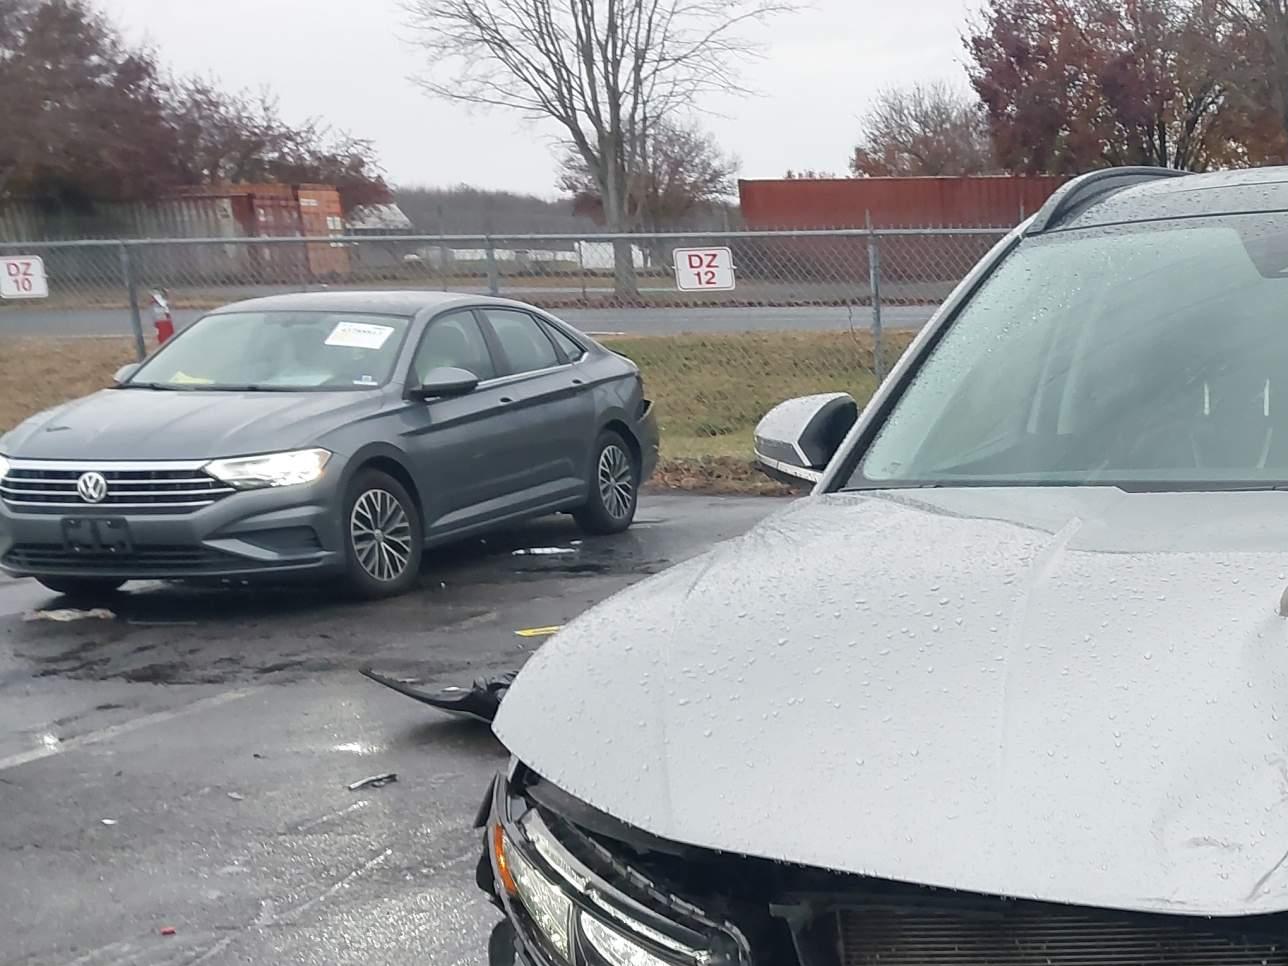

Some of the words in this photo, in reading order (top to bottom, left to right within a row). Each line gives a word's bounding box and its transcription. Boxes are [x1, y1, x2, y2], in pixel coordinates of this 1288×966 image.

[688, 254, 719, 269] DZ
[7, 262, 33, 276] DZ
[13, 278, 32, 291] 10
[694, 270, 717, 285] 12
